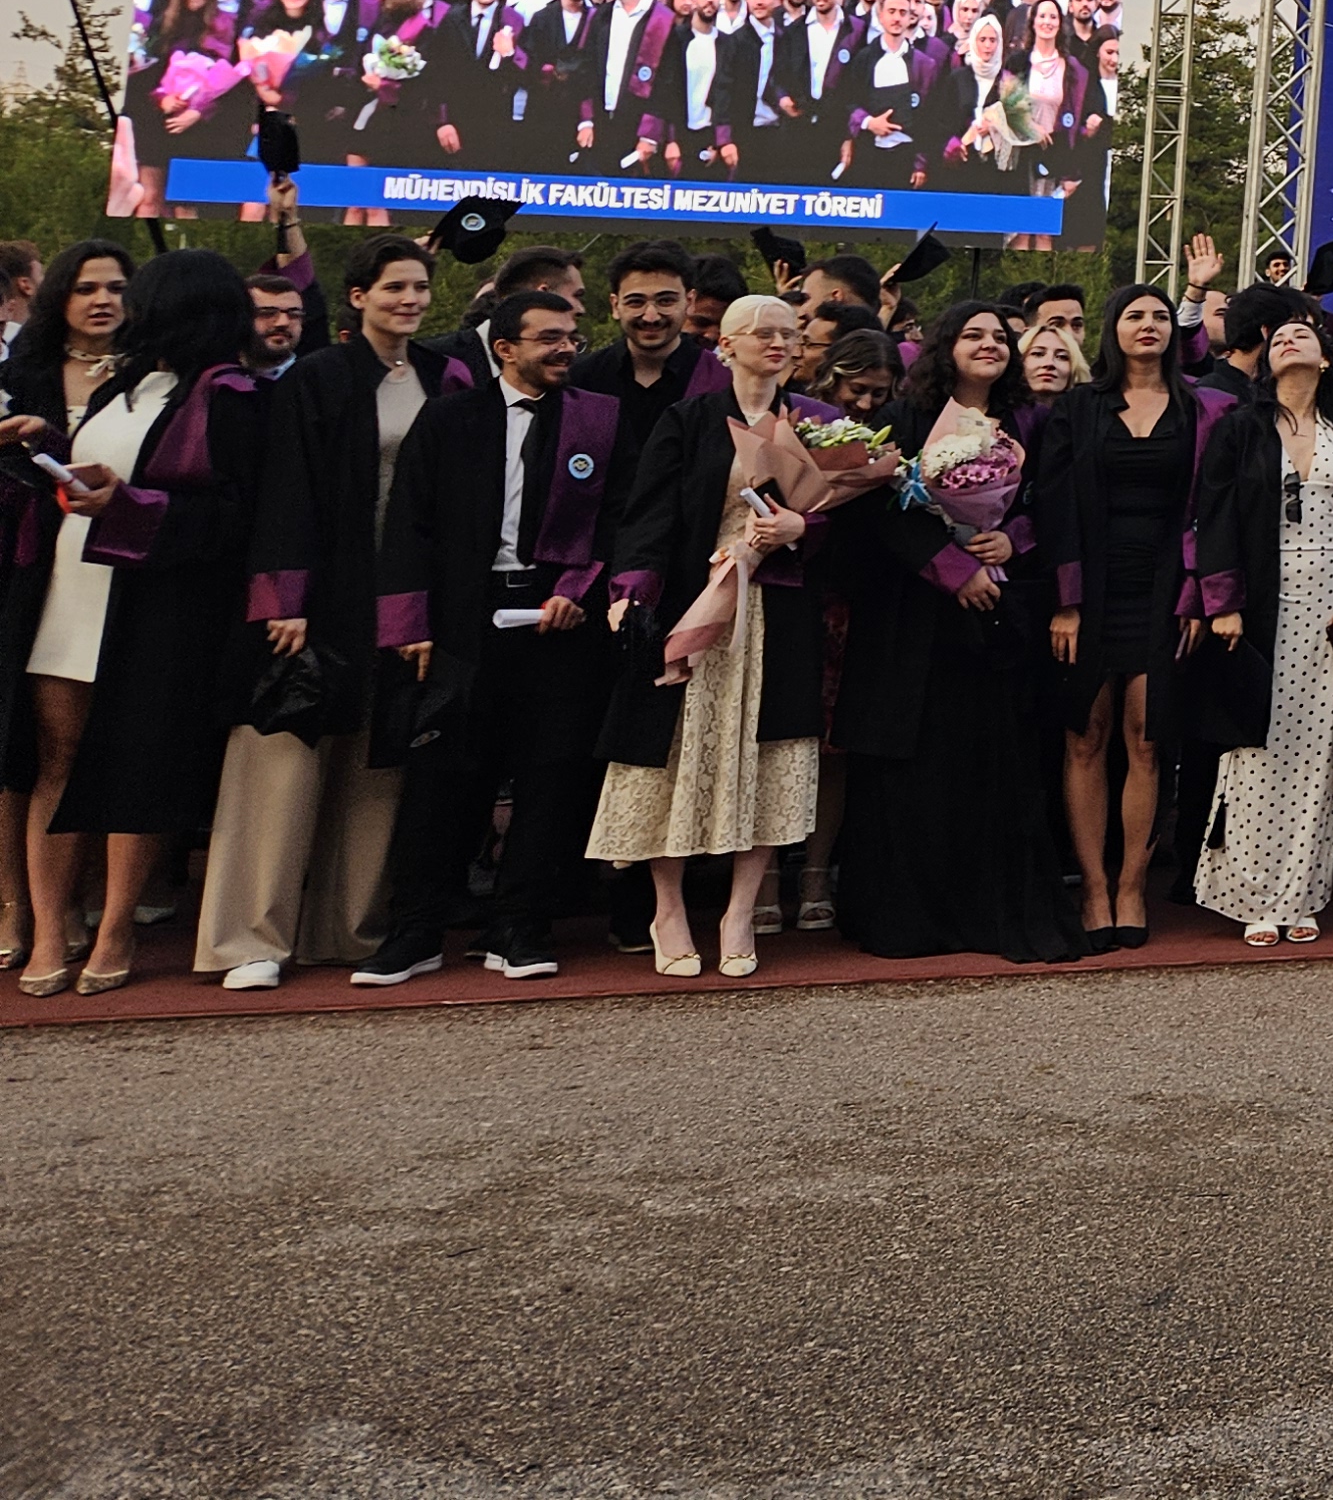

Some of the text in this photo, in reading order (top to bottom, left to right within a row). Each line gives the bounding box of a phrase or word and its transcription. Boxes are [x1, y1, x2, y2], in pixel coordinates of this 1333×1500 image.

[548, 182, 671, 211] FAKÜLTESİ
[673, 187, 800, 216] MEZUNİYET
[801, 193, 884, 219] TÖRENİ
